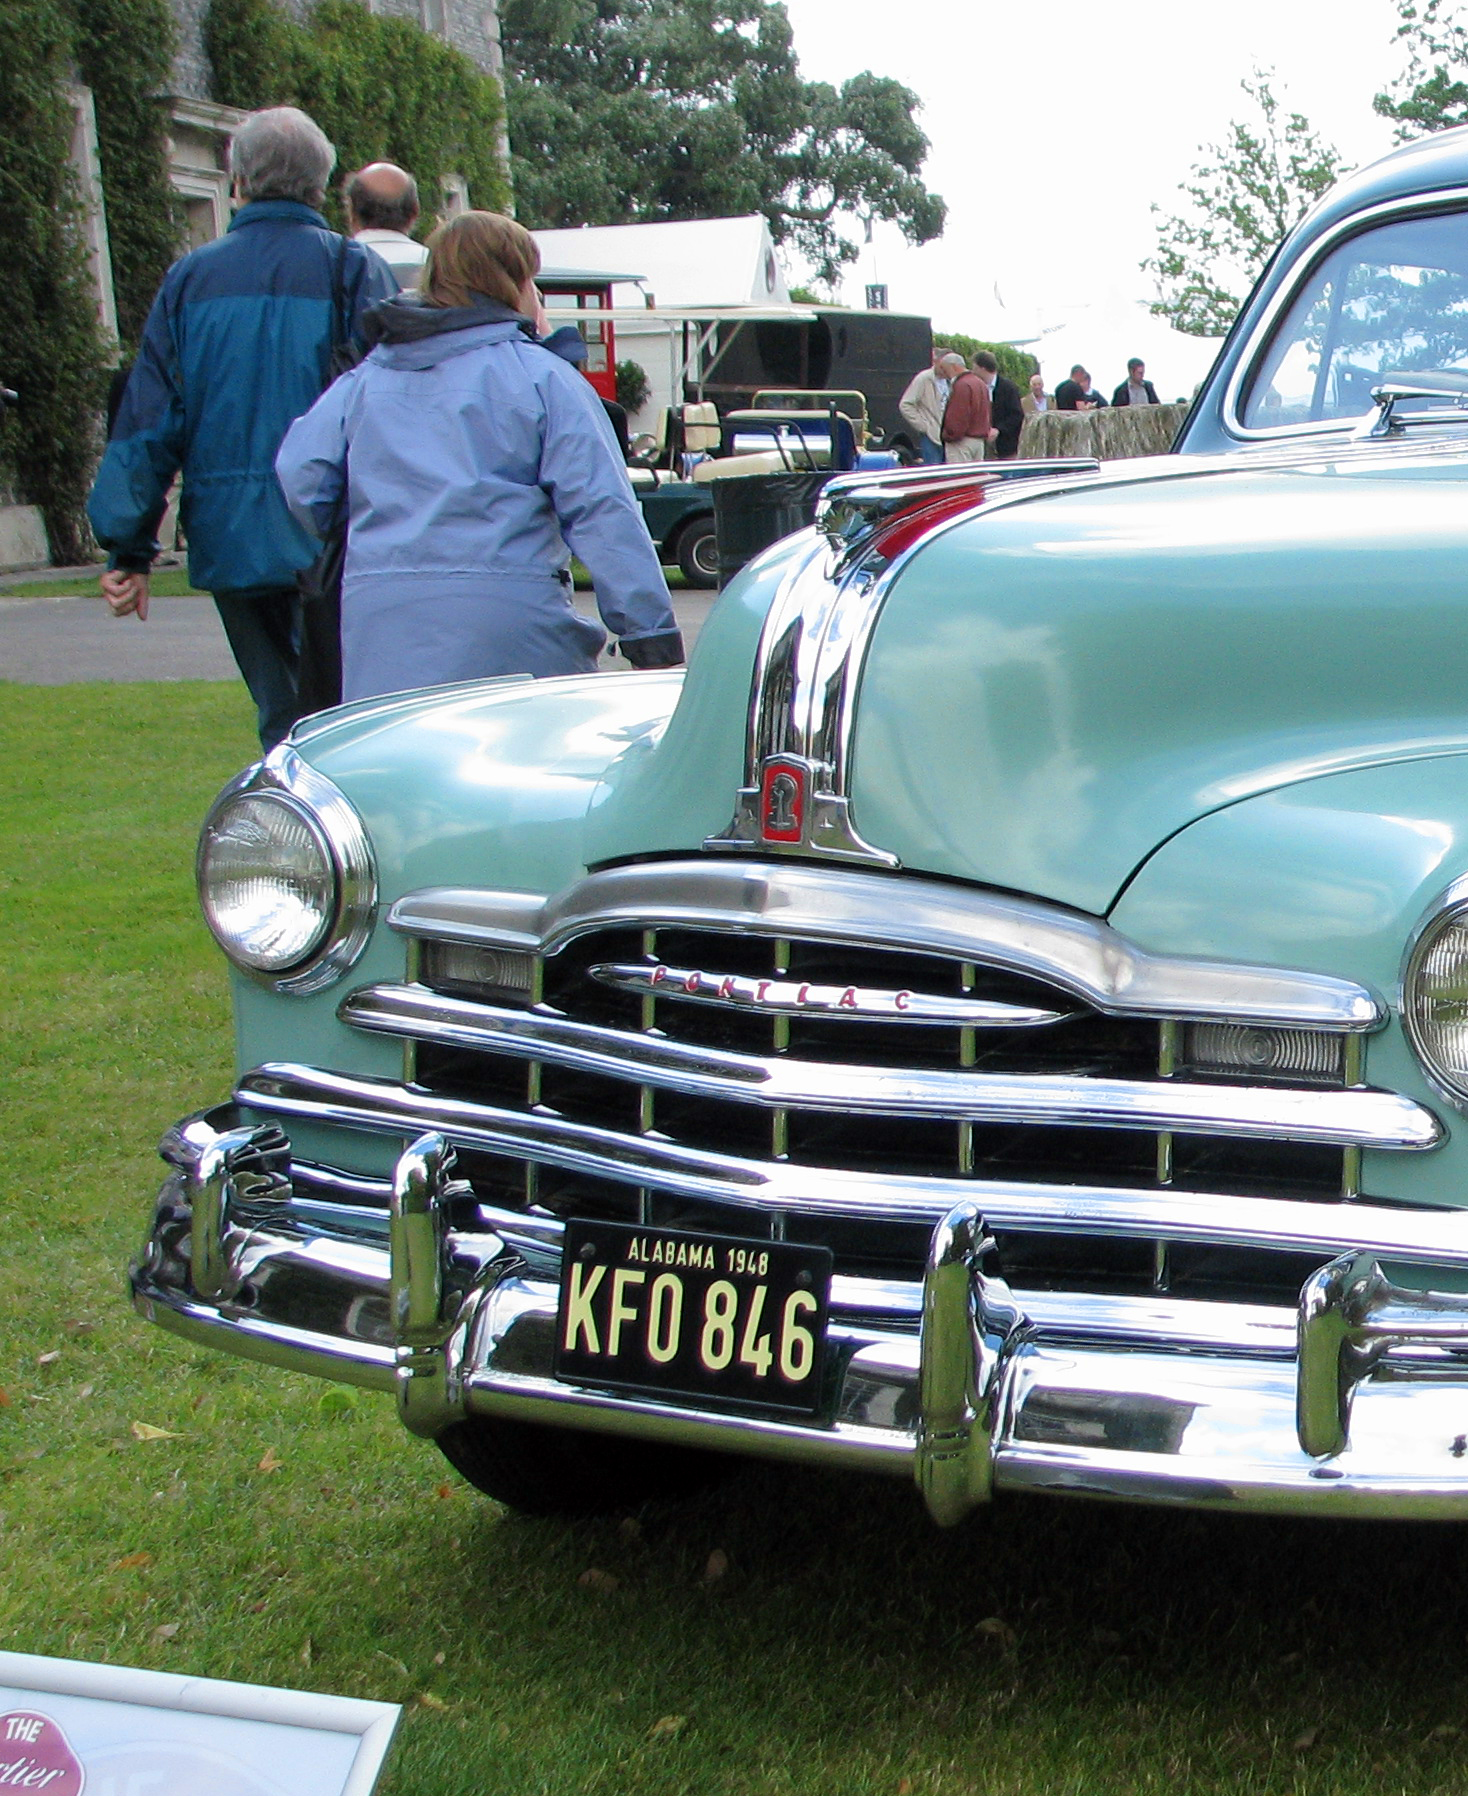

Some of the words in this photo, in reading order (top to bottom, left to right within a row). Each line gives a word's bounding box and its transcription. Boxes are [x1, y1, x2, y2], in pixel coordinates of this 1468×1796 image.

[651, 965, 912, 1011] PONTIAC
[628, 1237, 715, 1270] ALABAMA
[728, 1248, 769, 1276] 1948
[700, 1279, 818, 1381] 846
[6, 1717, 45, 1743] THE
